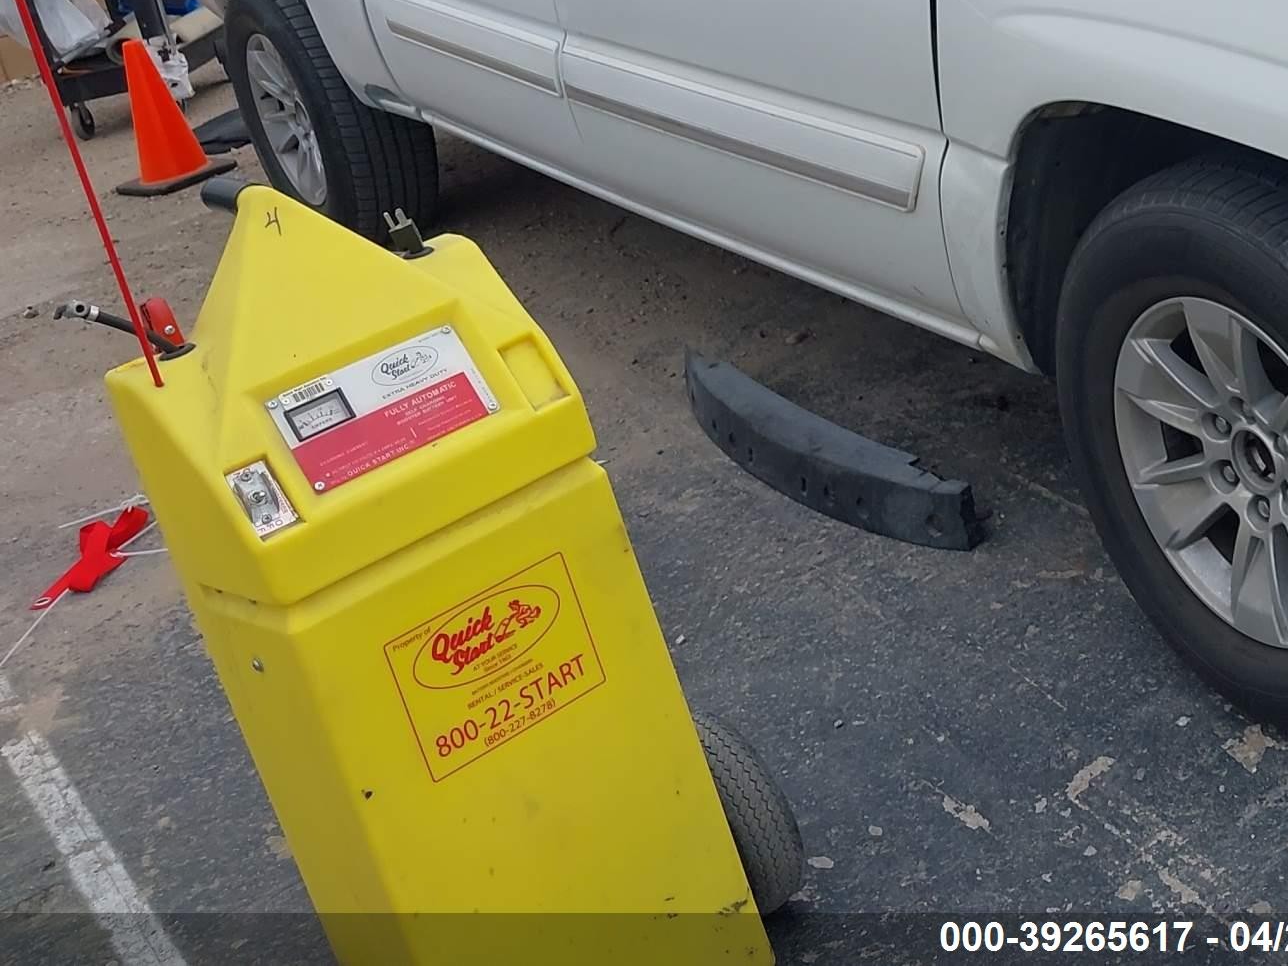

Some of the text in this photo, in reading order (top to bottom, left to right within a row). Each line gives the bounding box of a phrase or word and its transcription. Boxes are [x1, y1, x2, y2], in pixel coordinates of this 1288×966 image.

[264, 206, 282, 237] 4
[380, 354, 409, 375] Quick
[391, 364, 411, 380] Start
[406, 377, 428, 389] HEAVY
[384, 401, 409, 417] FULLY
[411, 381, 457, 406] AUTOMATIC
[347, 463, 371, 477] QUICK
[372, 449, 394, 465] START
[392, 626, 432, 652] Property of
[431, 606, 495, 664] Quick
[450, 633, 496, 675] Start
[435, 653, 584, 758] 800-22-START
[467, 692, 494, 709] RENTAL
[484, 697, 556, 747] (800-227-8278)
